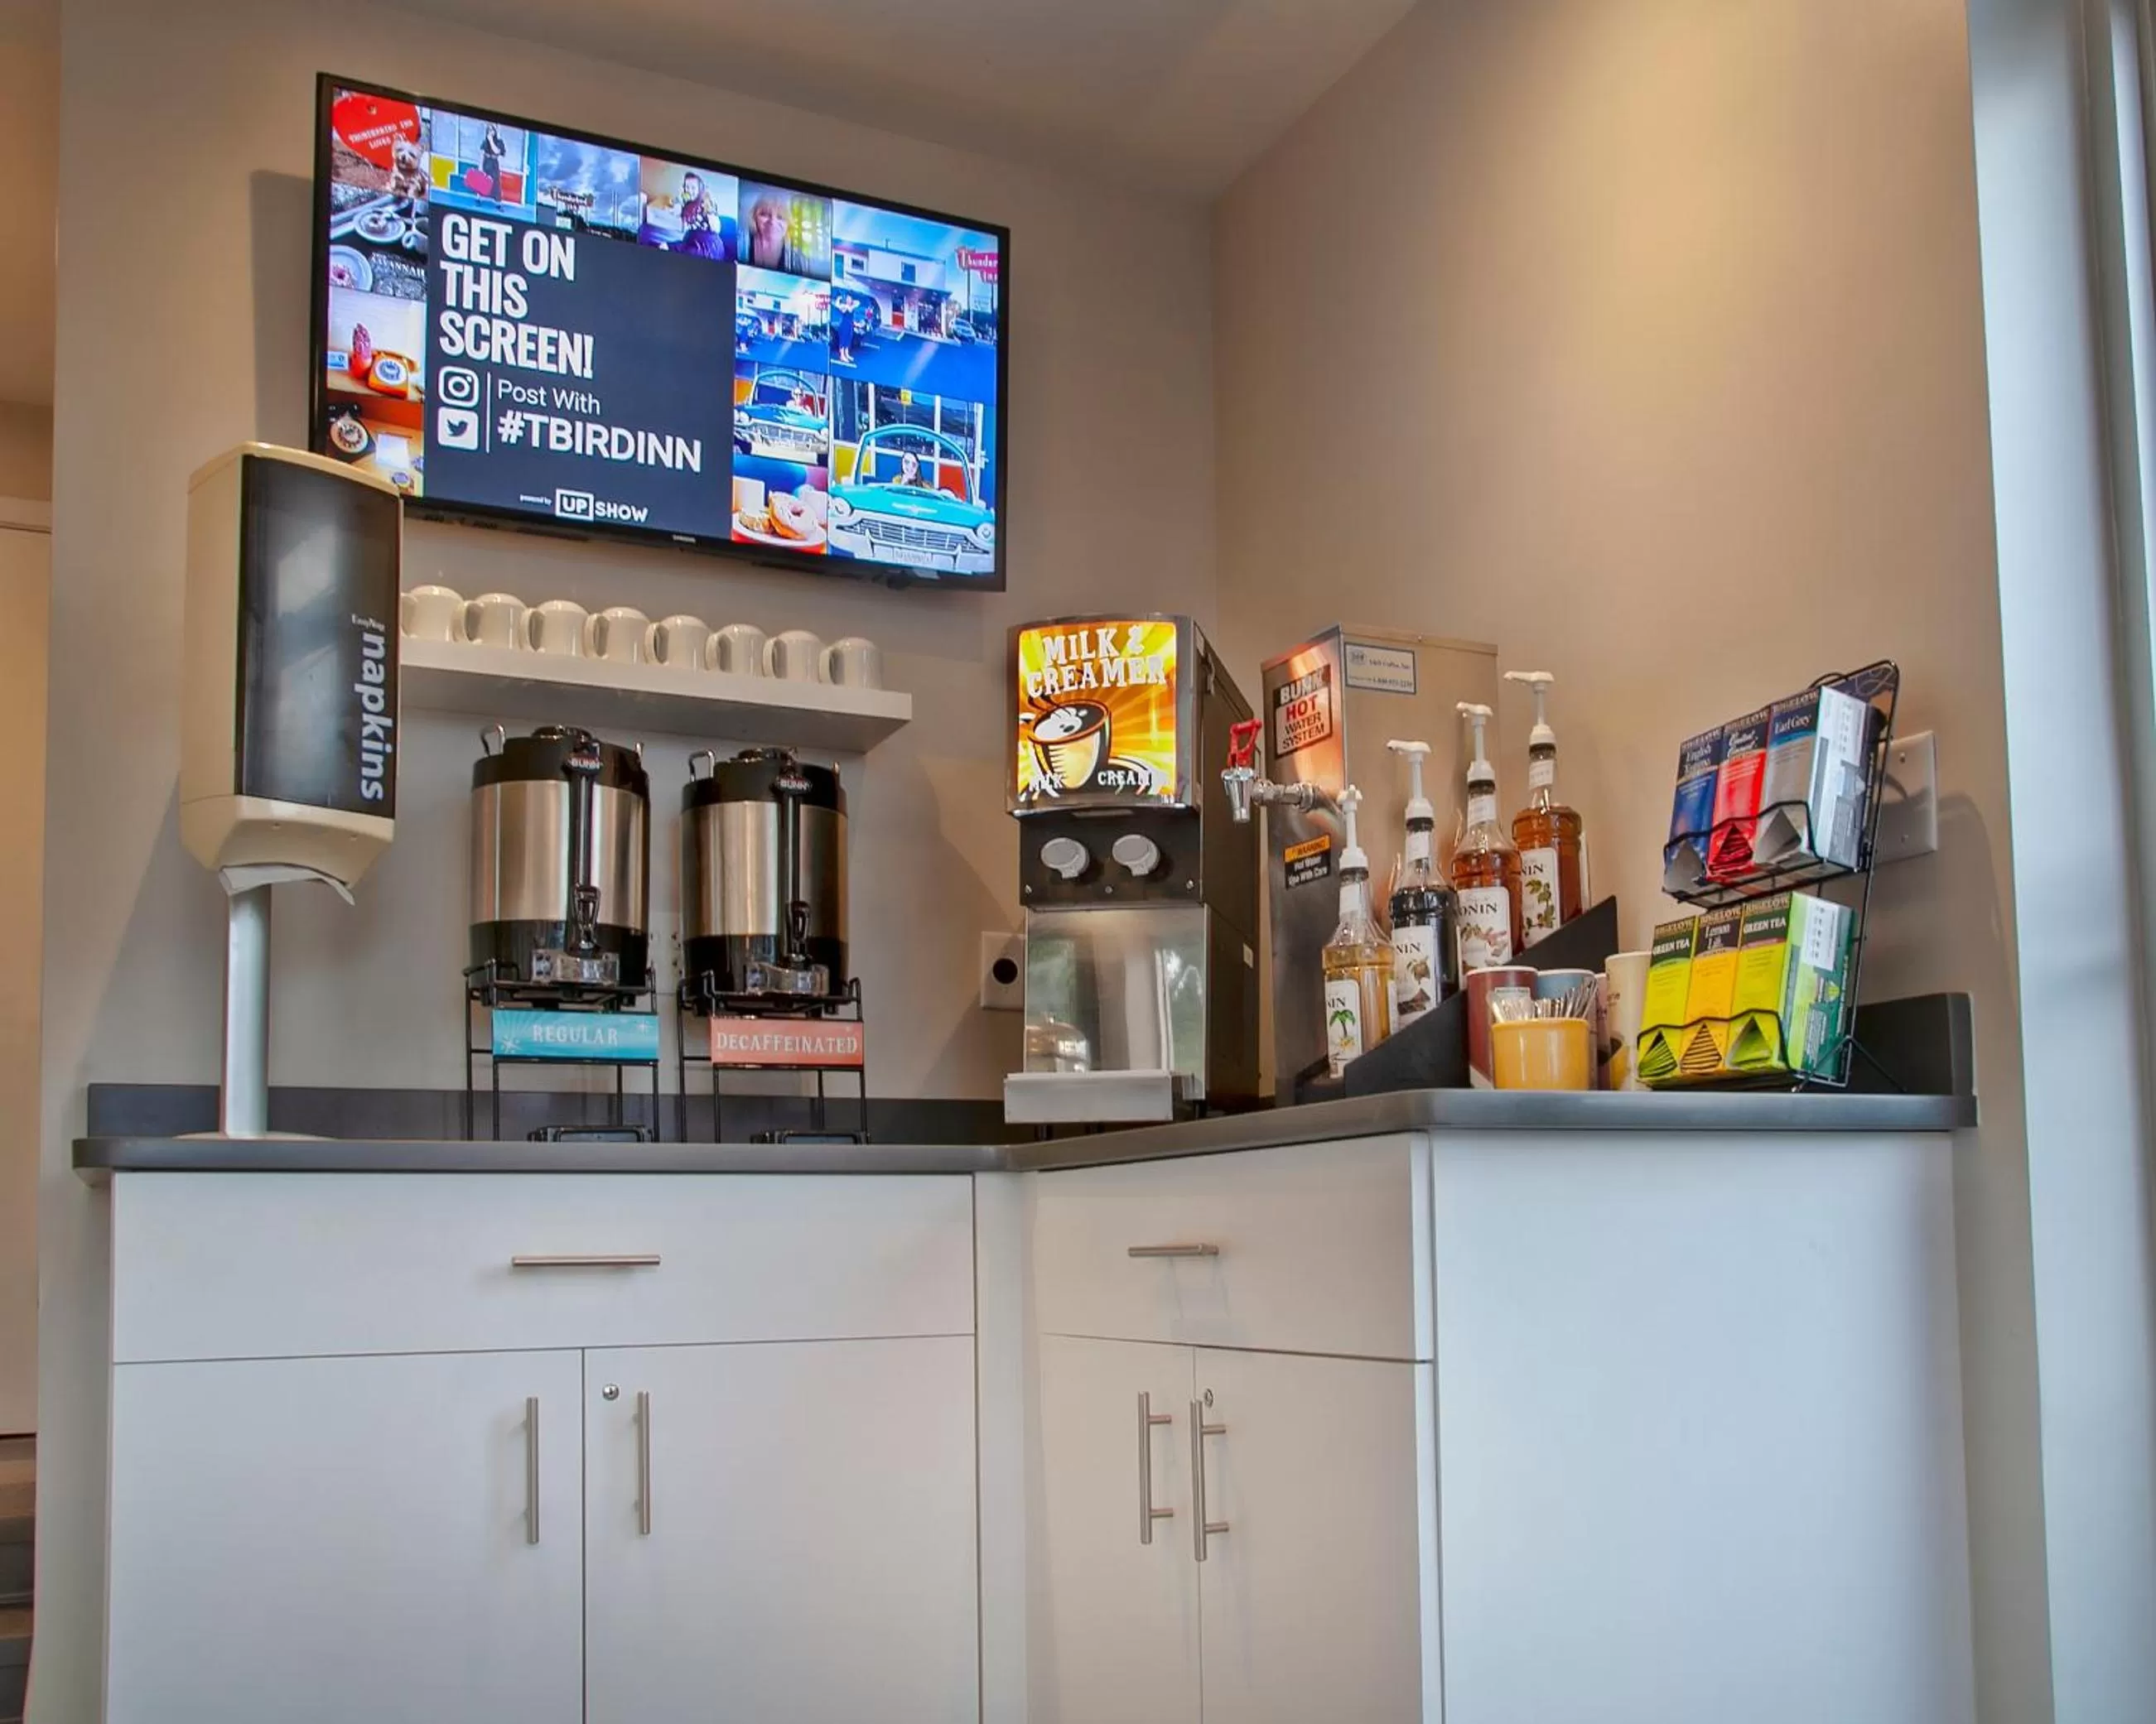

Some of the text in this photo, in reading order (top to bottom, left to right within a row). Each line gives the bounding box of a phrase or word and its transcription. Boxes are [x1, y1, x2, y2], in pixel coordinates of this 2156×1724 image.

[441, 213, 576, 282] GET ON
[439, 261, 528, 320] THIS
[439, 311, 595, 380] SCREEN!
[498, 378, 600, 415] Post With
[498, 410, 702, 473] #TBIRDINN
[562, 496, 649, 522] UP SHOW
[1043, 625, 1145, 666] MILK &
[1027, 655, 1167, 698] CREAMER
[1281, 667, 1325, 704] BUNN
[355, 632, 393, 802] napkins
[1285, 711, 1322, 734] WATER
[1286, 695, 1319, 722] HOT
[1283, 723, 1325, 749] SYSTEM
[1743, 917, 1787, 934] GREEN TEA
[1652, 937, 1691, 956] GREEN TEA
[533, 1025, 619, 1046] REGULAR
[716, 1032, 858, 1054] DECAFFEINATED
